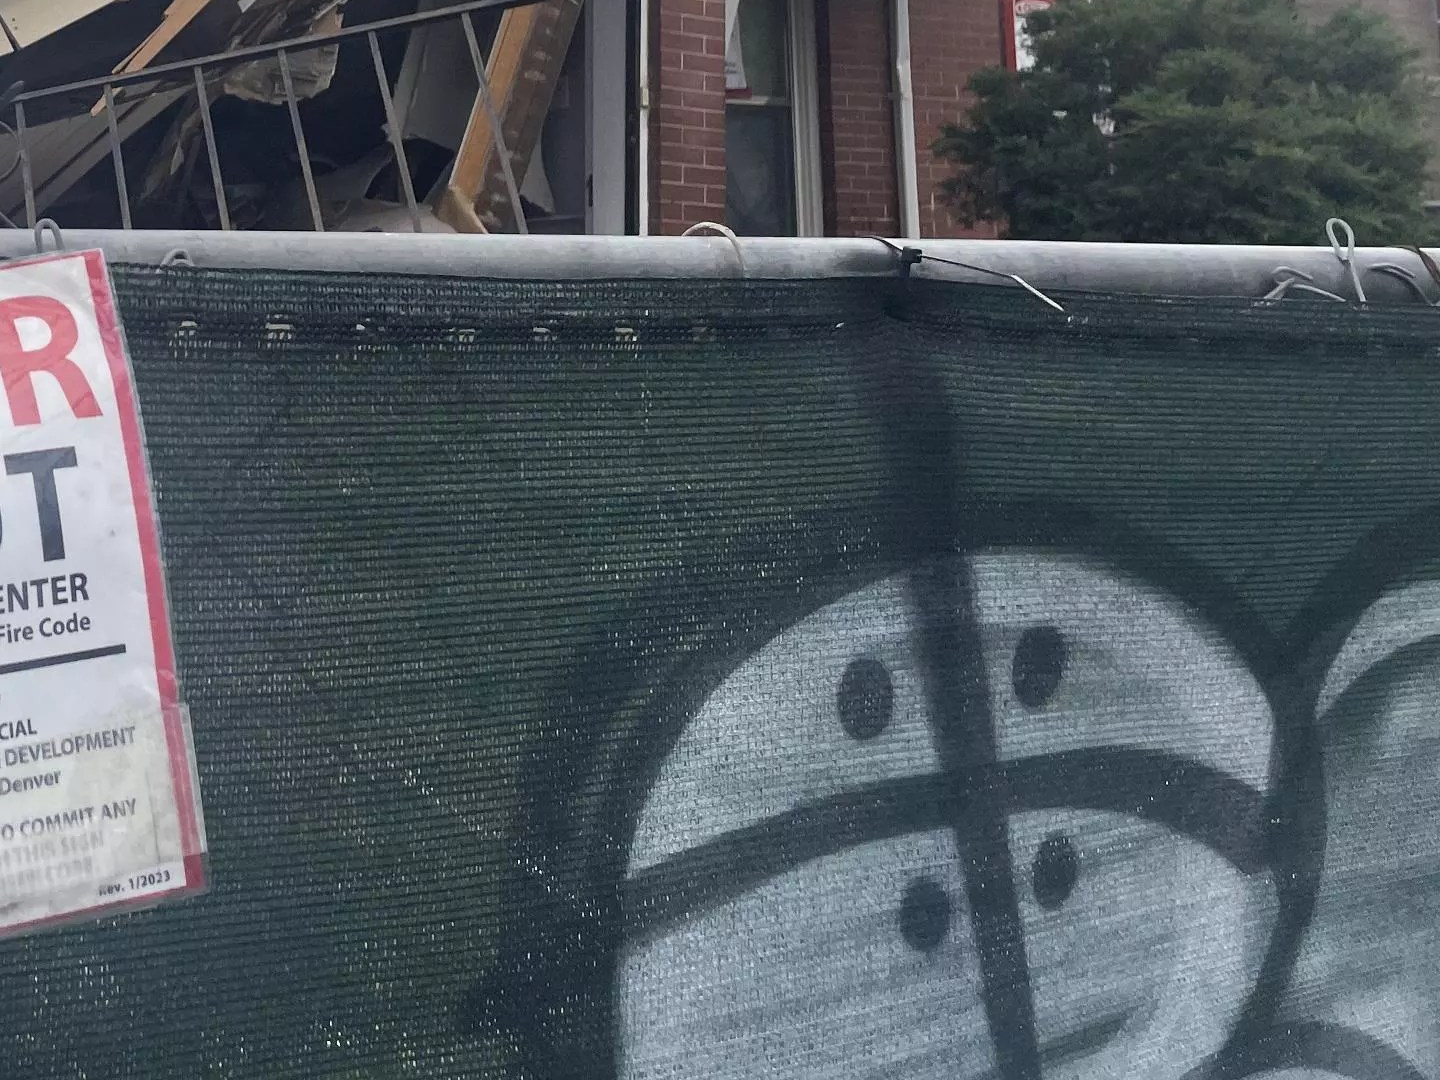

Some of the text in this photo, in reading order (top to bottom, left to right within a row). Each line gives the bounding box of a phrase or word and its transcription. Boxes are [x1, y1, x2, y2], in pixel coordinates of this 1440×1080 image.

[39, 612, 91, 638] Code
[4, 726, 136, 767] DEVELOPMENT
[0, 770, 62, 797] Denver
[19, 806, 94, 836] COMMIT
[101, 798, 138, 820] ANY
[128, 869, 172, 890] 1/2023
